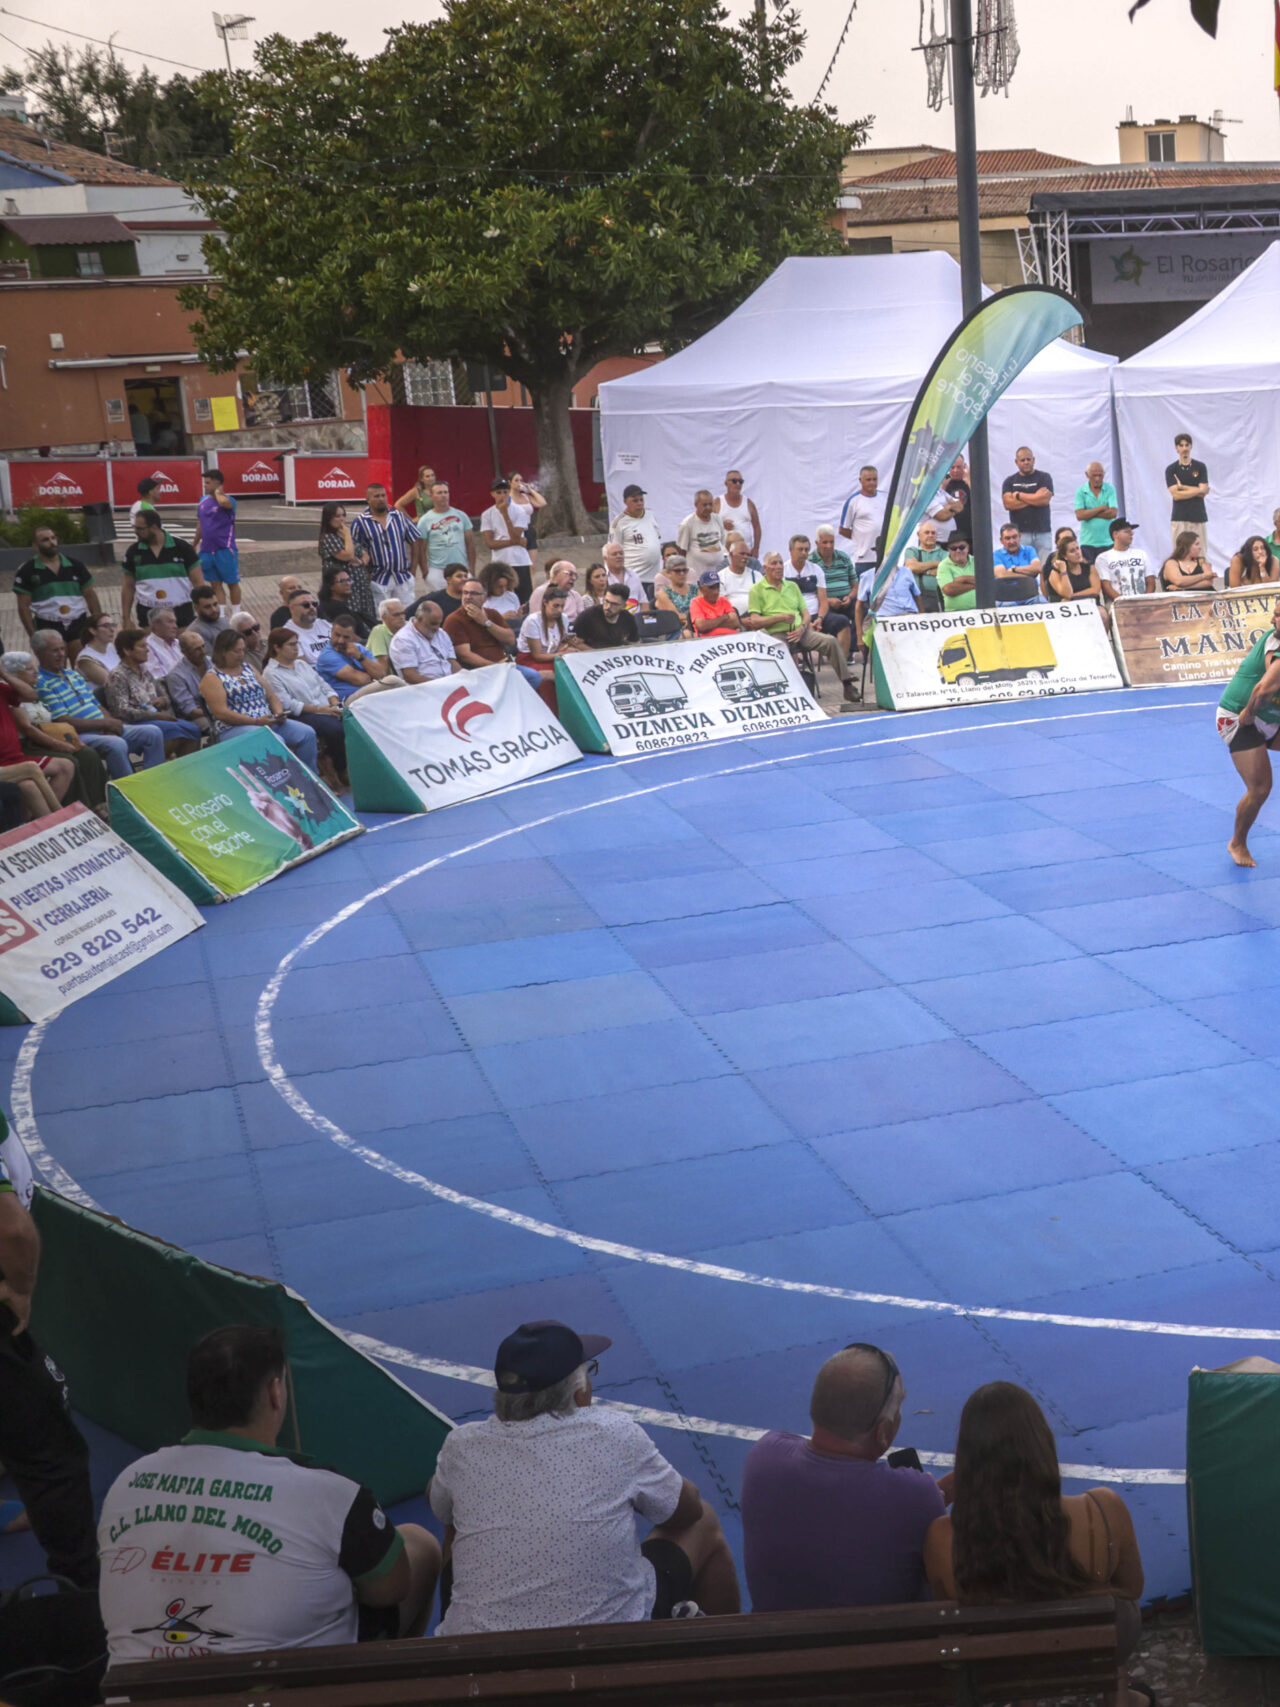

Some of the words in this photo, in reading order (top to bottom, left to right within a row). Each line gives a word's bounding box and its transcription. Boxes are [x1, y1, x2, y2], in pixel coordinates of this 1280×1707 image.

[1157, 256, 1173, 273] El
[39, 486, 83, 496] DORADA
[159, 484, 179, 493] ADA
[242, 474, 279, 483] DORADA
[318, 480, 355, 489] DORADA
[879, 613, 976, 633] Transporte
[980, 607, 1055, 625] Dizmeva
[1060, 604, 1094, 618] S.L.
[1171, 602, 1201, 622] LA
[1212, 597, 1280, 617] CUEV
[1221, 617, 1247, 629] DE
[581, 654, 686, 687] TRANSPORTES
[688, 641, 785, 675] TRANSPORTES
[1163, 661, 1201, 672] Camino
[1060, 676, 1077, 684] Cruz
[1089, 673, 1117, 682] Tenerife
[1179, 671, 1207, 681] Llano
[1209, 670, 1225, 678] del
[720, 697, 815, 724] DIZMEVA
[613, 712, 715, 739] DIZMEVA
[408, 750, 492, 789] TOMAS
[489, 724, 569, 764] GRACIA
[168, 808, 191, 827] El
[186, 792, 233, 824] Rosario
[190, 826, 215, 843] con
[213, 817, 230, 834] el
[207, 829, 255, 858] deporte
[1, 858, 16, 878] Y
[10, 835, 67, 874] SERVICIO
[58, 816, 110, 849] TÉCNICO
[10, 876, 65, 911] PUERTAS
[61, 842, 133, 885] AUTOMÁTICAS
[33, 917, 48, 932] Y
[44, 885, 113, 928] CERRAJERÍA
[40, 951, 83, 979] 629
[81, 929, 122, 957] 820
[121, 907, 162, 934] 542
[128, 1472, 158, 1489] JOSE
[209, 1479, 274, 1502] GARCIA
[110, 1517, 131, 1543] C.L.
[135, 1504, 187, 1526] LLANO
[192, 1505, 227, 1528] DEL
[231, 1515, 283, 1555] MORO
[151, 1545, 256, 1573] ÉLITE
